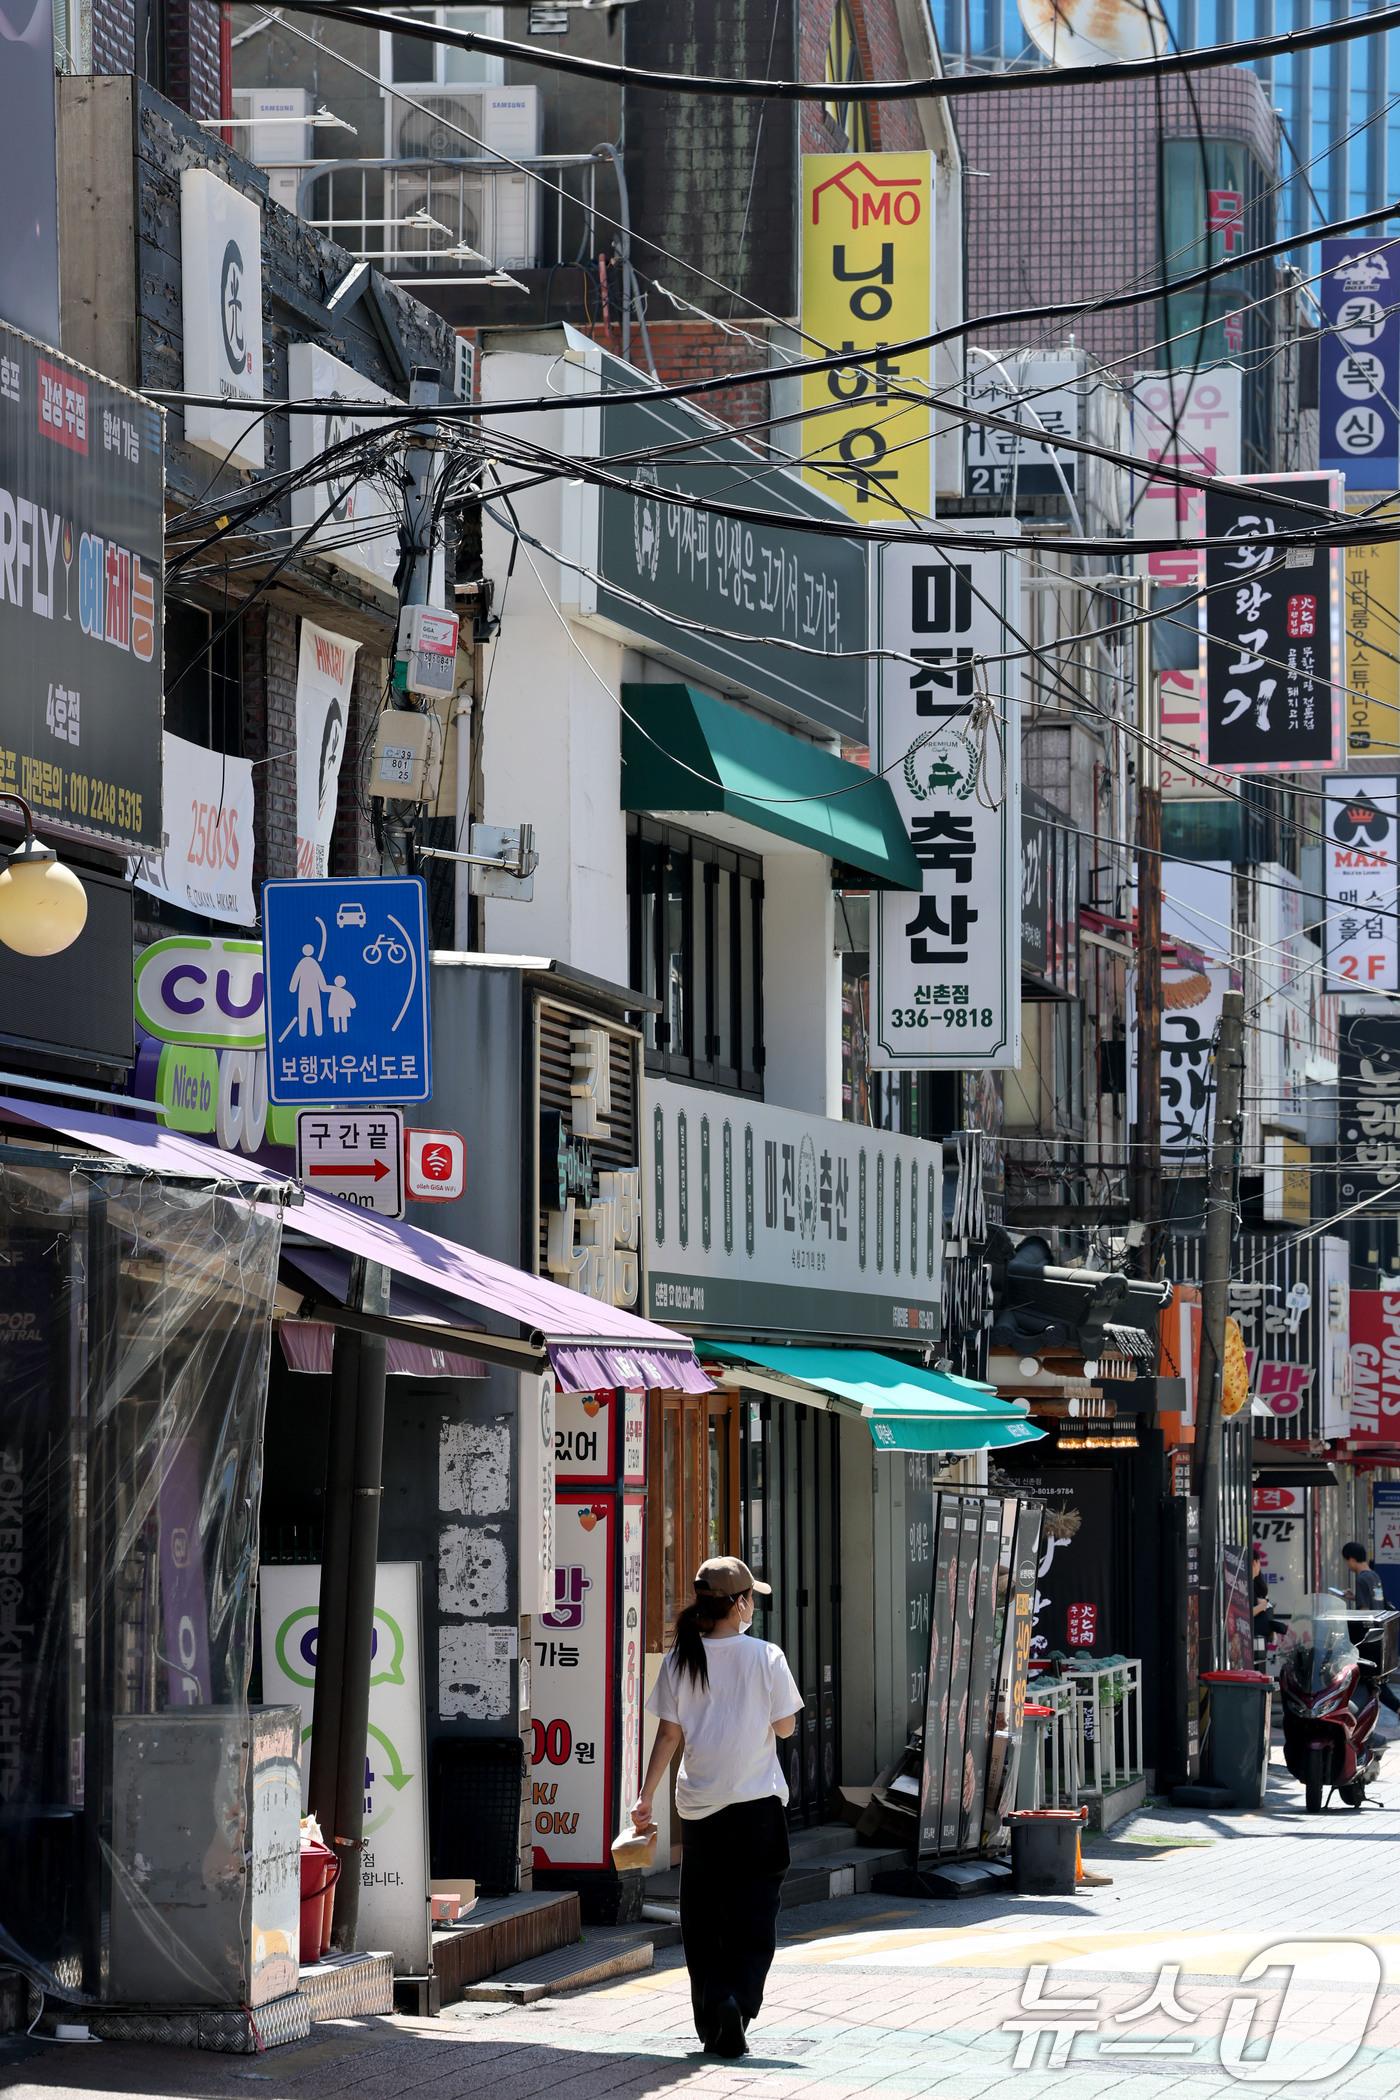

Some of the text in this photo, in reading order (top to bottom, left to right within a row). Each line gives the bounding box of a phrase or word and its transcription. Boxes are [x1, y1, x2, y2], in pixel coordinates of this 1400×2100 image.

[260, 104, 294, 112] SAMSUNG
[492, 101, 526, 109] SAMSUNG
[1342, 302, 1379, 448] 킥복싱
[41, 375, 86, 441] 감성 주점
[103, 410, 140, 464] 합석 가능
[971, 468, 1012, 494] 2F
[715, 517, 757, 611] 인생은
[760, 547, 798, 639] 고기서
[802, 572, 844, 654] 고기다.
[1300, 597, 1315, 635] 火と肉
[313, 634, 347, 687] HIKARU
[46, 682, 81, 747] 4호점
[1287, 686, 1299, 730] 돼지고기
[1303, 696, 1316, 731] 전문점
[923, 740, 958, 748] PREMIUM
[392, 760, 408, 770] 801
[397, 771, 409, 780] 25
[905, 564, 979, 964] 미진 축산
[21, 755, 62, 811] 대관문의
[69, 772, 89, 816] 010
[90, 778, 116, 824] 2248
[118, 786, 143, 833] 5315
[1334, 851, 1388, 868] MAX
[1338, 955, 1386, 981] 2F
[160, 964, 265, 1019] CU
[914, 984, 969, 1005] 신촌점
[891, 1007, 993, 1028] 336-9818
[280, 1054, 419, 1084] 보행자우선도로
[172, 1064, 212, 1113] Nice to
[765, 1139, 796, 1232] 미진
[820, 1149, 849, 1241] 축산
[0, 1329, 43, 1342] NTRAL
[1381, 1296, 1400, 1417] SPORTS
[1350, 1342, 1381, 1435] GAME
[1022, 1477, 1042, 1486] 신촌점
[909, 1522, 930, 1563] 인생은
[909, 1593, 929, 1634] 고기서
[1080, 1605, 1094, 1644] 火と肉
[534, 1641, 580, 1668] 가능
[535, 1811, 580, 1834] OK!
[360, 1852, 375, 1867] 점
[359, 1872, 404, 1887] 합니다.
